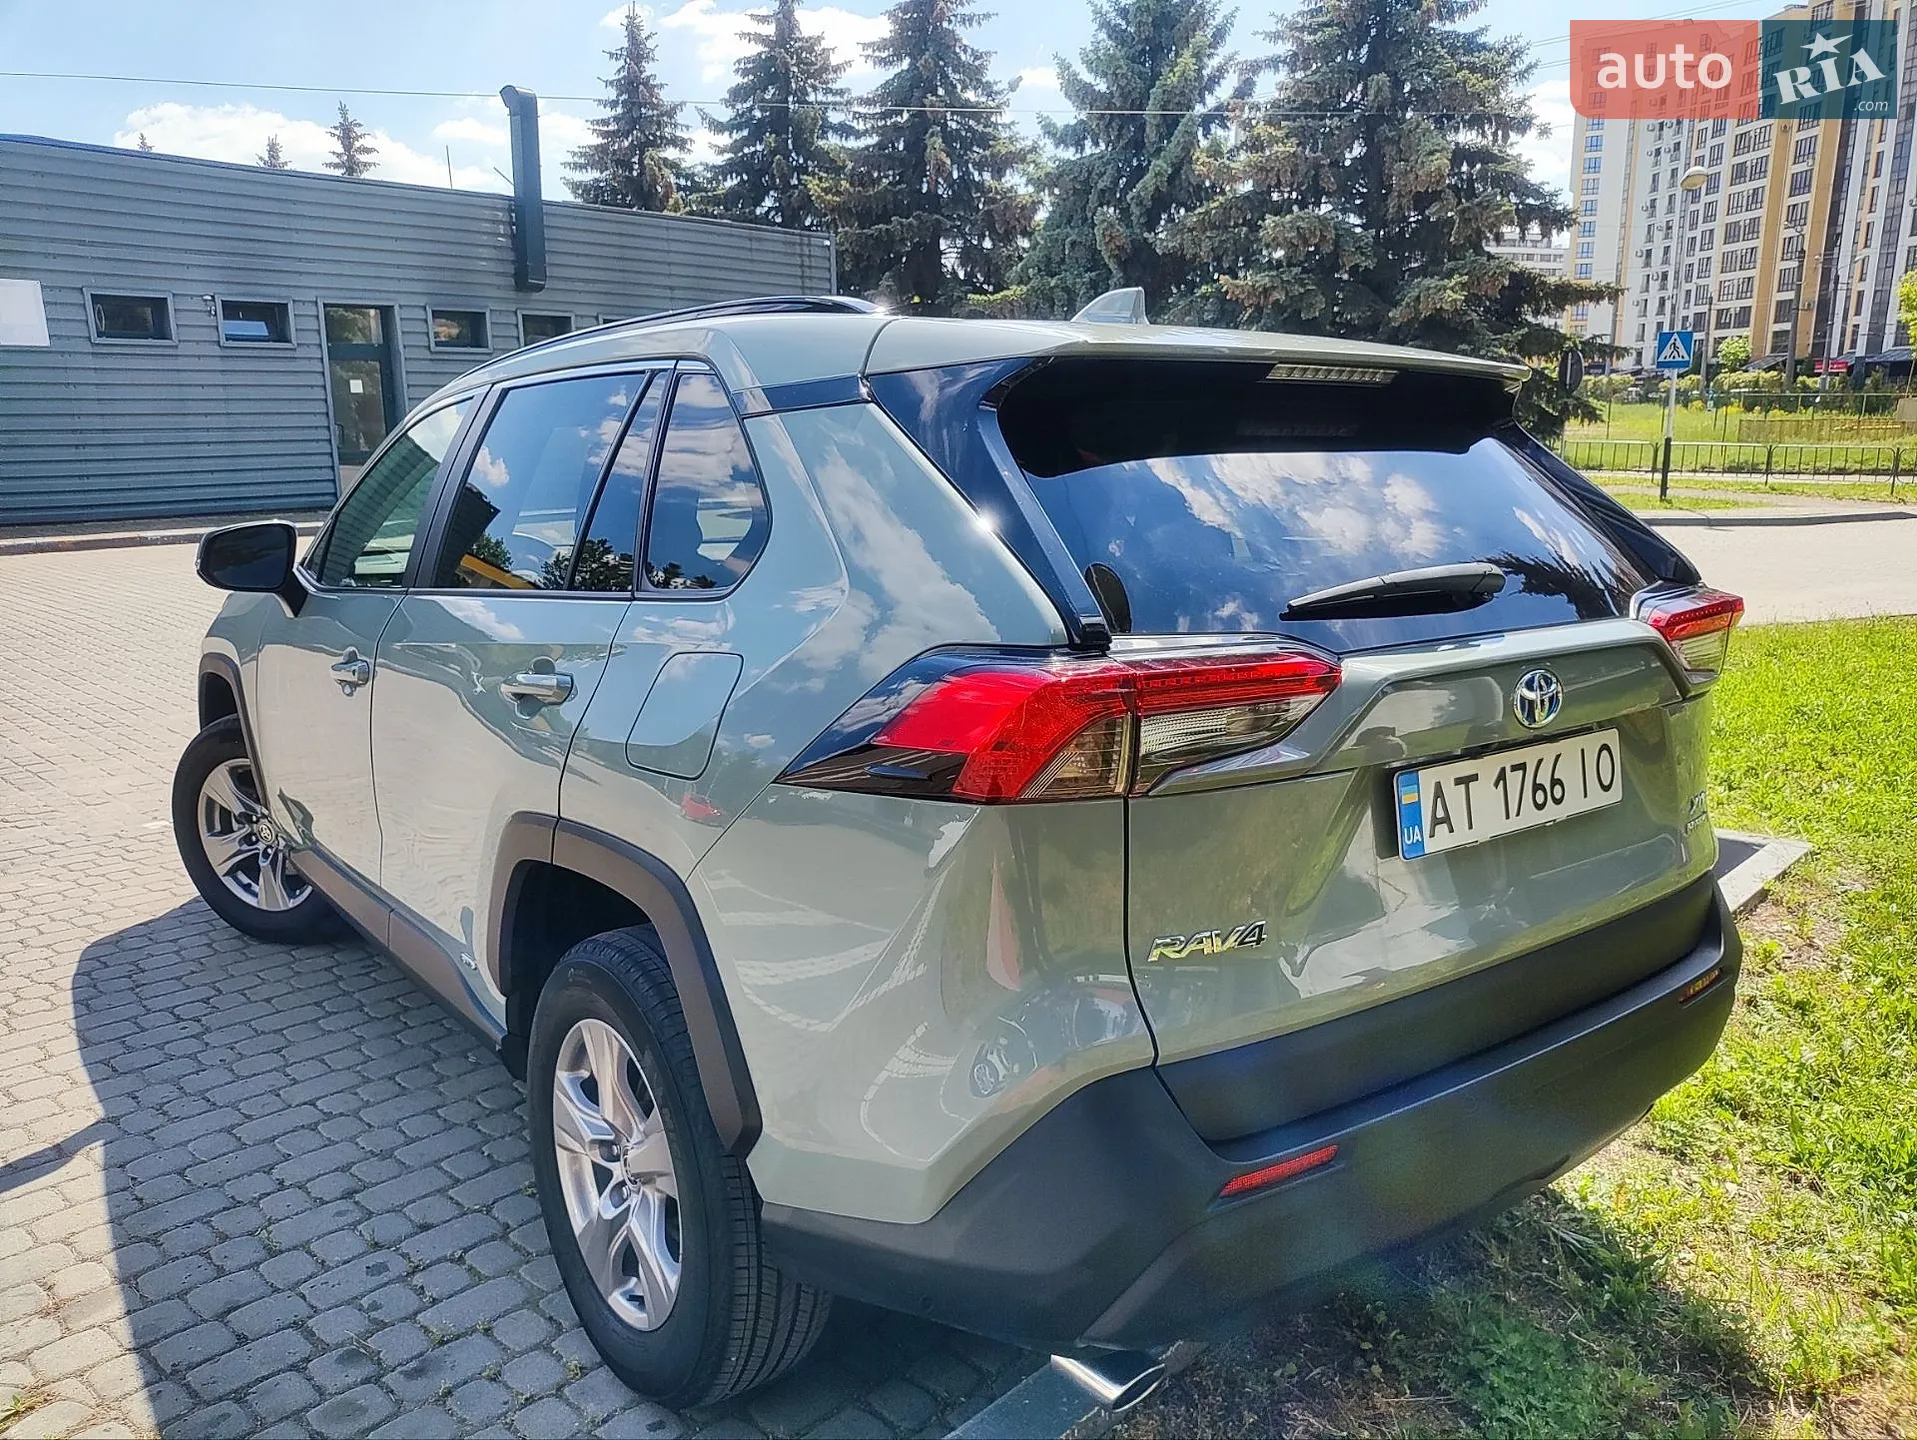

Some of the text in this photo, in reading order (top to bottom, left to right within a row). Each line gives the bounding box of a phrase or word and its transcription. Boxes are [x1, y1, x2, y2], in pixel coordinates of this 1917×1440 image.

[1428, 743, 1616, 839] AT 1766 IO
[1404, 825, 1422, 845] UA
[1147, 920, 1268, 963] RAV4
